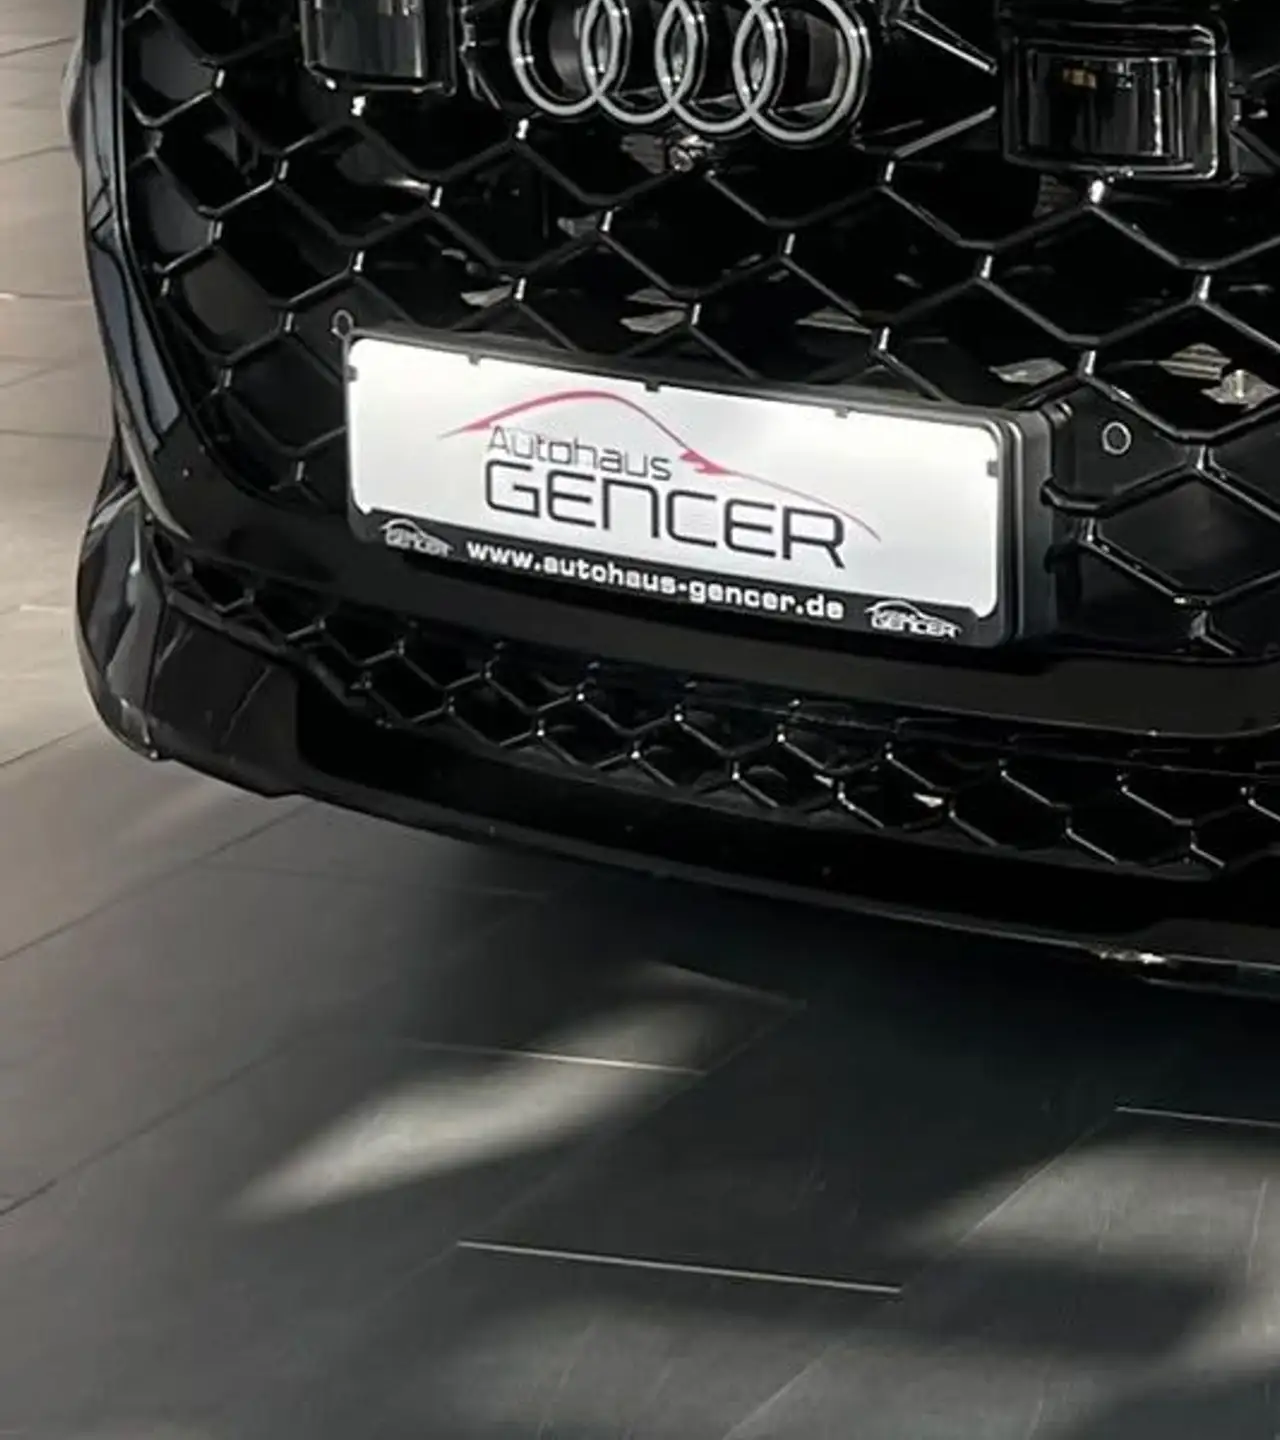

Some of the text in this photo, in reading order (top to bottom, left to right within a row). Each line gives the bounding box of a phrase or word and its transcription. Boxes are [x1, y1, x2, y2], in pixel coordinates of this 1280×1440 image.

[488, 425, 672, 481] Autohaus
[484, 459, 845, 569] GENCER
[466, 540, 845, 621] www.autohaus-gencer.de
